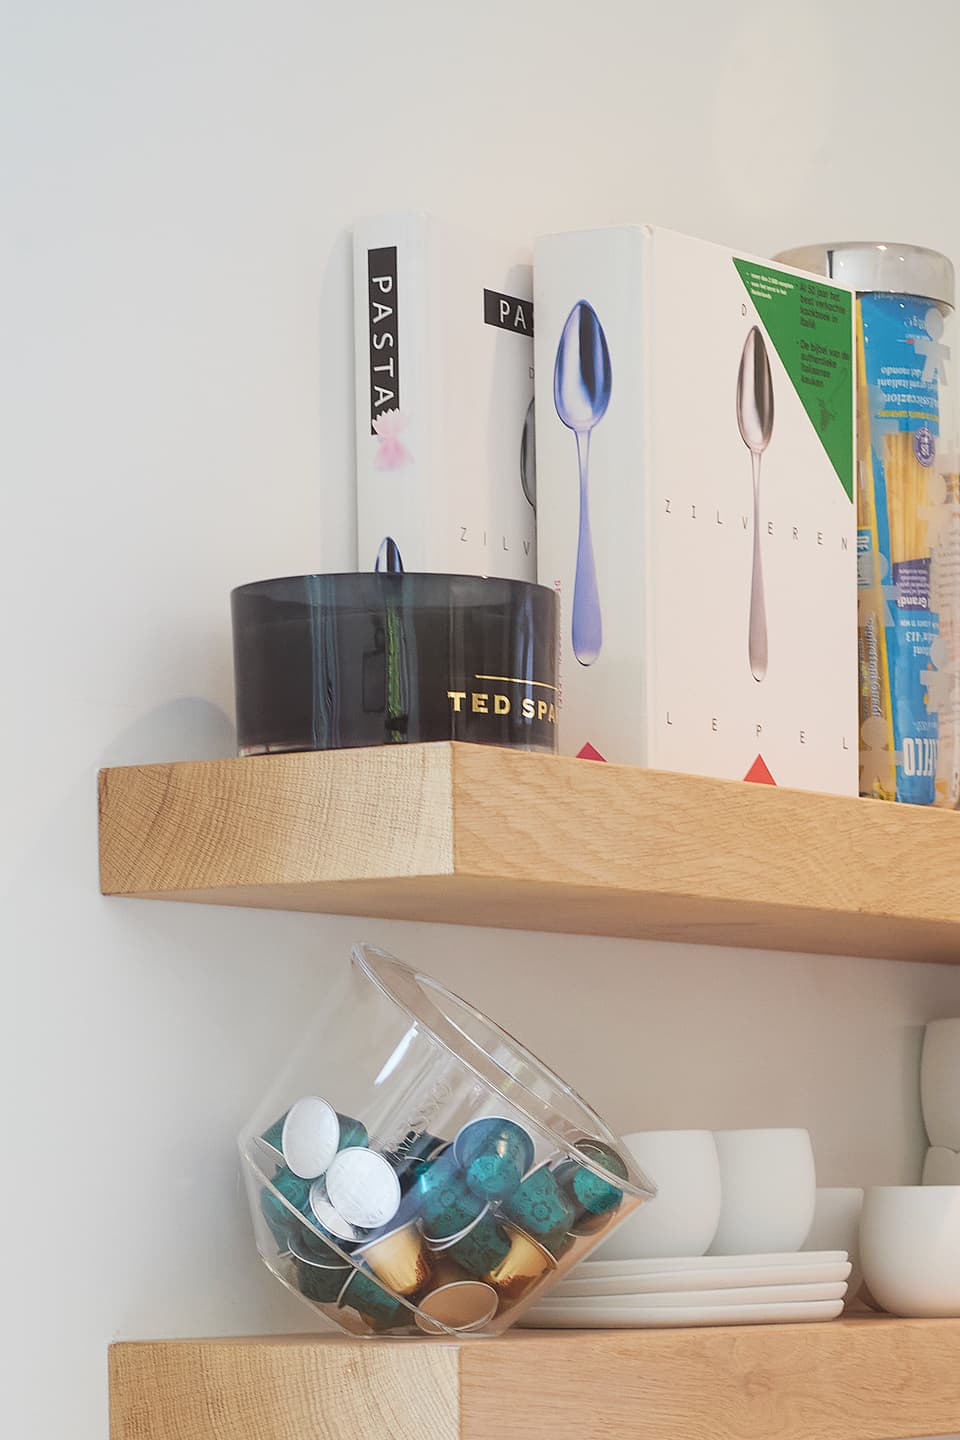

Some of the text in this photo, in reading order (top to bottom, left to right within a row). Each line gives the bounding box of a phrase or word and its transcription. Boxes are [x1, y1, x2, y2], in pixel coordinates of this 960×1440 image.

[499, 299, 528, 330] PA
[370, 275, 395, 407] PASTA
[664, 499, 849, 552] ZILVEREN
[447, 690, 511, 716] TED
[664, 713, 849, 752] LEPEL
